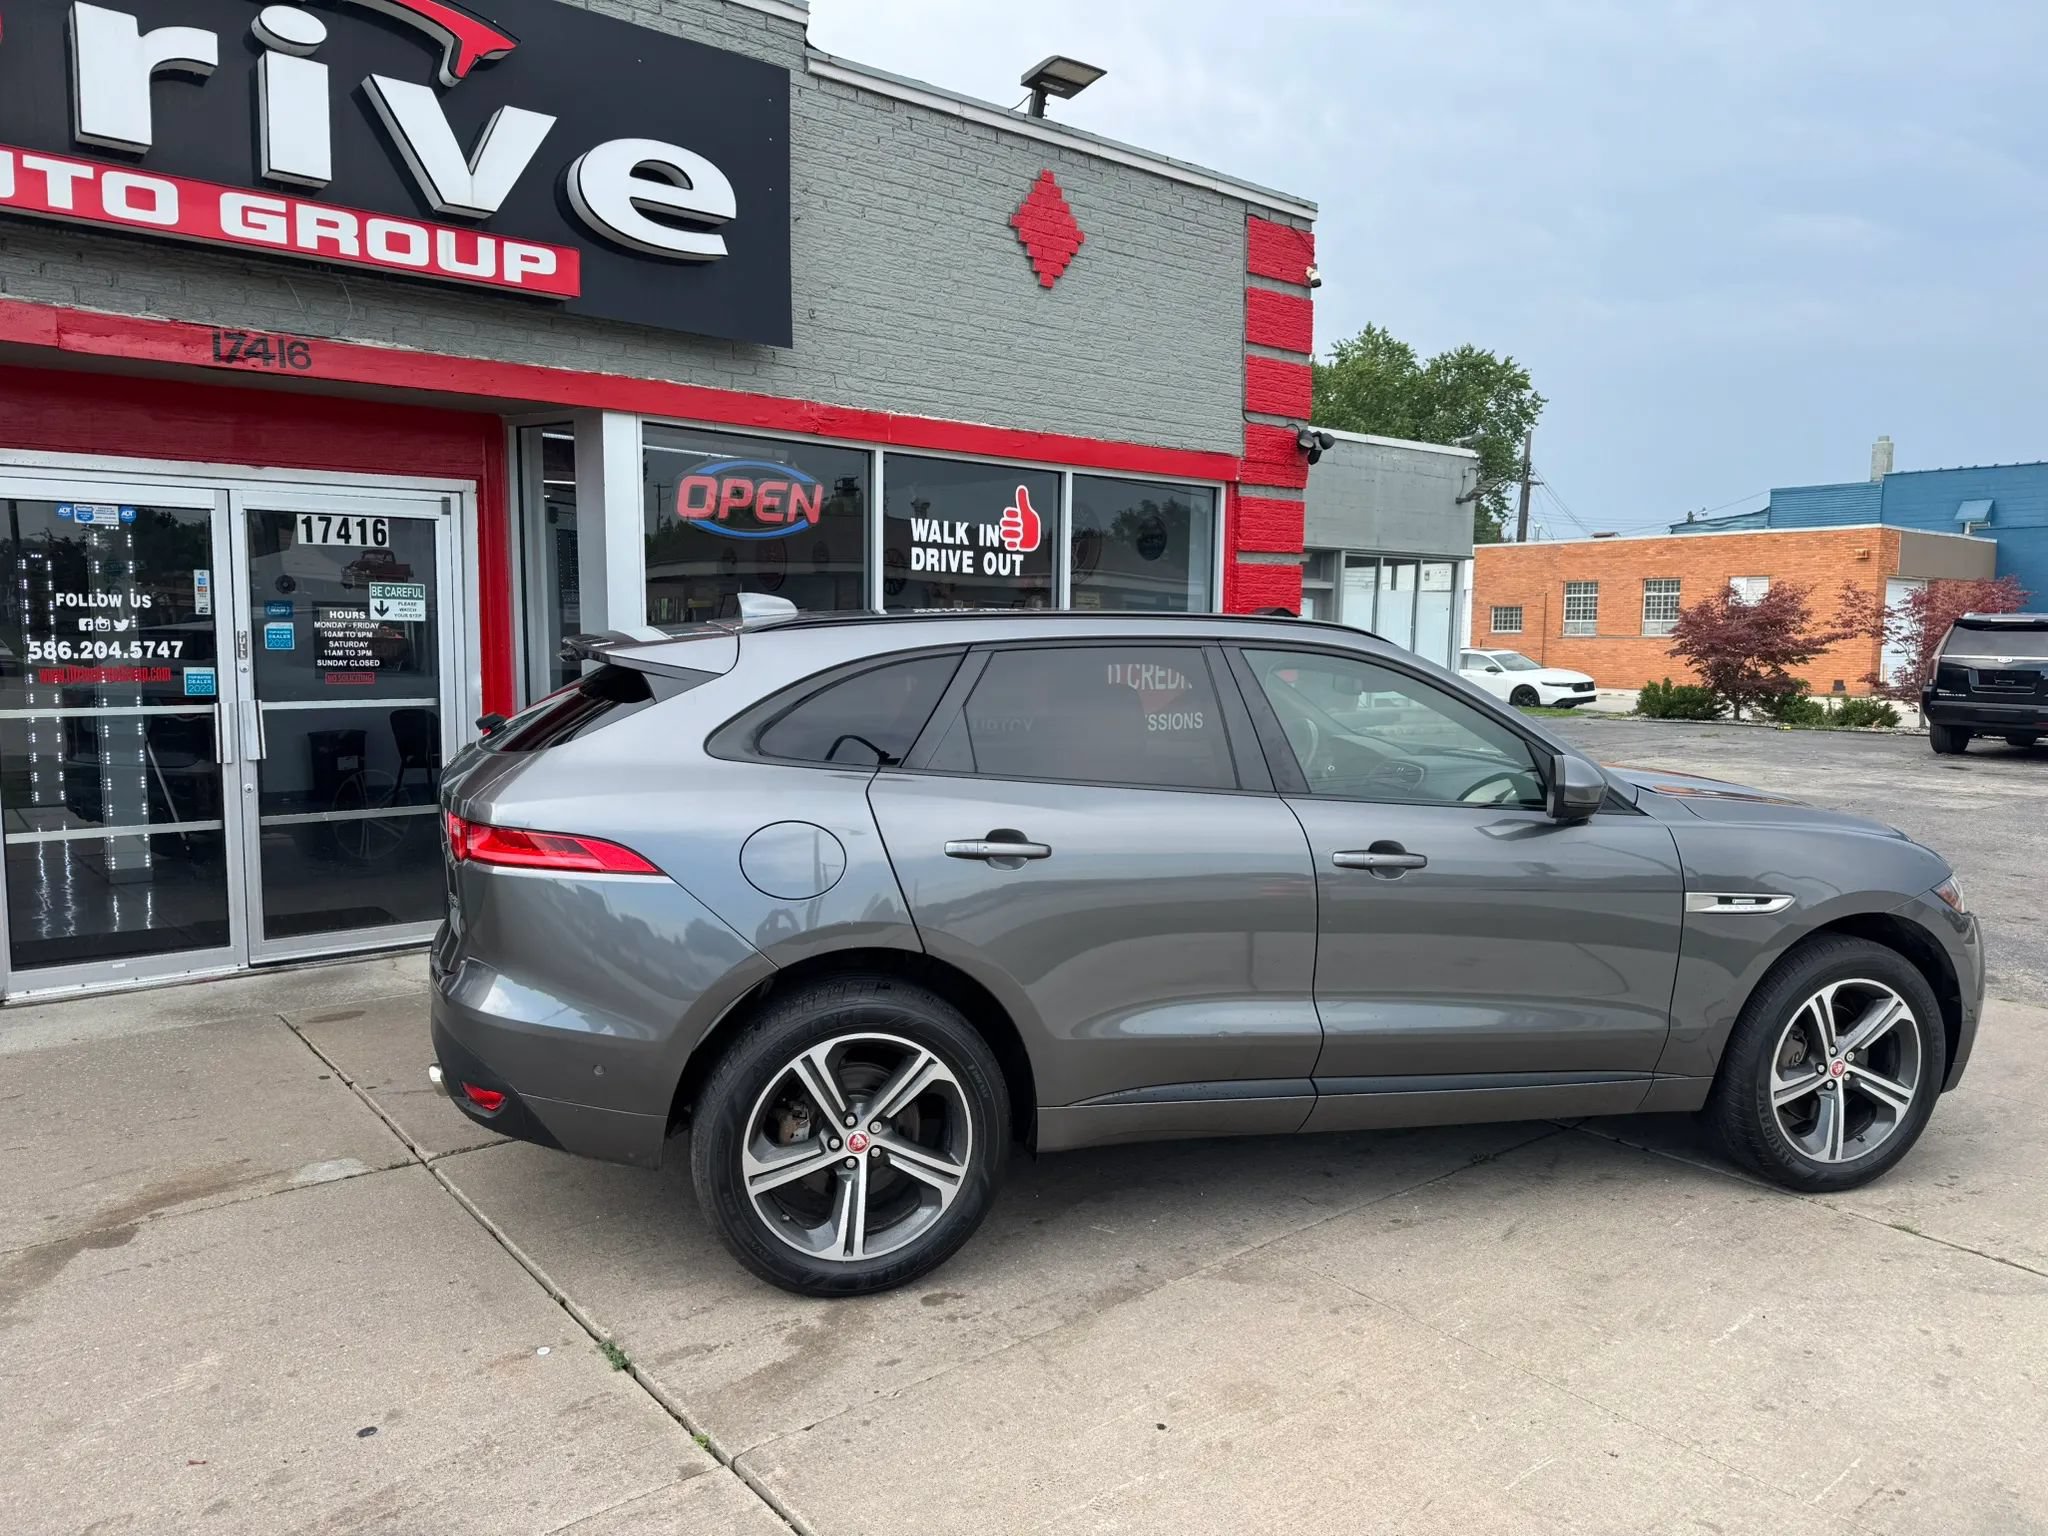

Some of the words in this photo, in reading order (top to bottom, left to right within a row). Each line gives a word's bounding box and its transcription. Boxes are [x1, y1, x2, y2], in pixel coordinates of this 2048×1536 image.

[68, 0, 738, 262] rive
[0, 149, 179, 226] TO
[219, 191, 557, 284] GROUP
[212, 328, 312, 370] 17416
[675, 471, 824, 527] OPEN
[301, 515, 387, 546] 17416
[910, 517, 969, 546] WALK
[978, 522, 999, 548] IN
[911, 546, 975, 575] DRIVE
[982, 552, 1025, 577] OUT
[55, 592, 123, 608] FOLLOW
[130, 592, 152, 609] US
[370, 586, 384, 597] BE
[385, 587, 423, 599] CAREFUL
[329, 610, 366, 620] HOURS
[314, 621, 347, 629] MONDAY
[352, 622, 380, 630] FRIDAY
[28, 640, 184, 660] 586.204.5747
[324, 649, 343, 657] 11AM
[345, 649, 356, 657] TO
[357, 649, 373, 657] 3PM
[328, 640, 369, 648] SATURDAY
[316, 659, 348, 667] SUNDAY
[349, 659, 380, 668] CLOSED
[1127, 663, 1193, 690] CREDI
[187, 684, 213, 693] 2023
[1143, 711, 1204, 732] SSIONS
